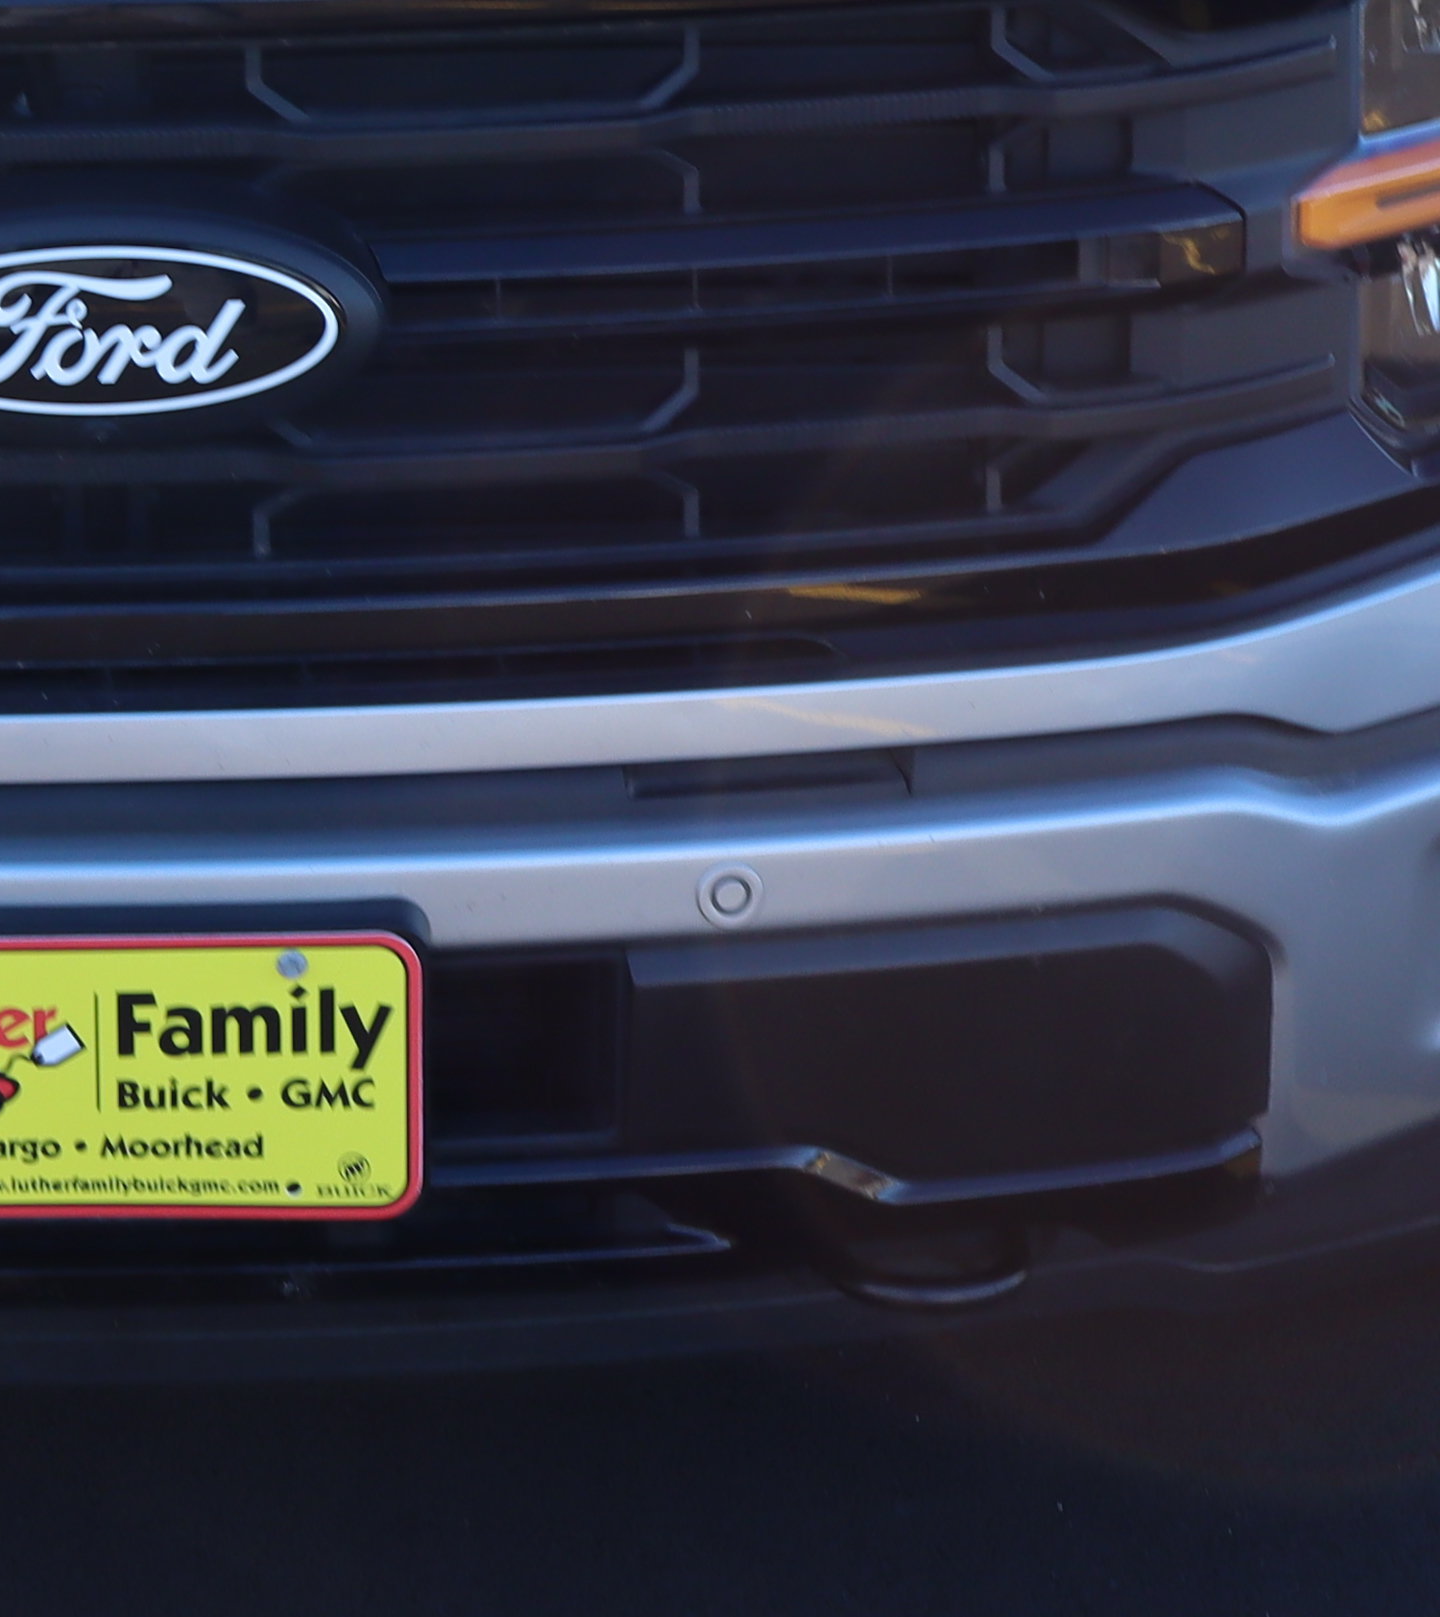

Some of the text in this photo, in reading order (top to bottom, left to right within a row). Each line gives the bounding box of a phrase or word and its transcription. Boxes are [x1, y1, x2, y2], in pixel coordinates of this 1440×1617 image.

[116, 985, 392, 1070] Family
[116, 1077, 376, 1111] Buick GMC
[100, 1133, 265, 1159] Moorhead
